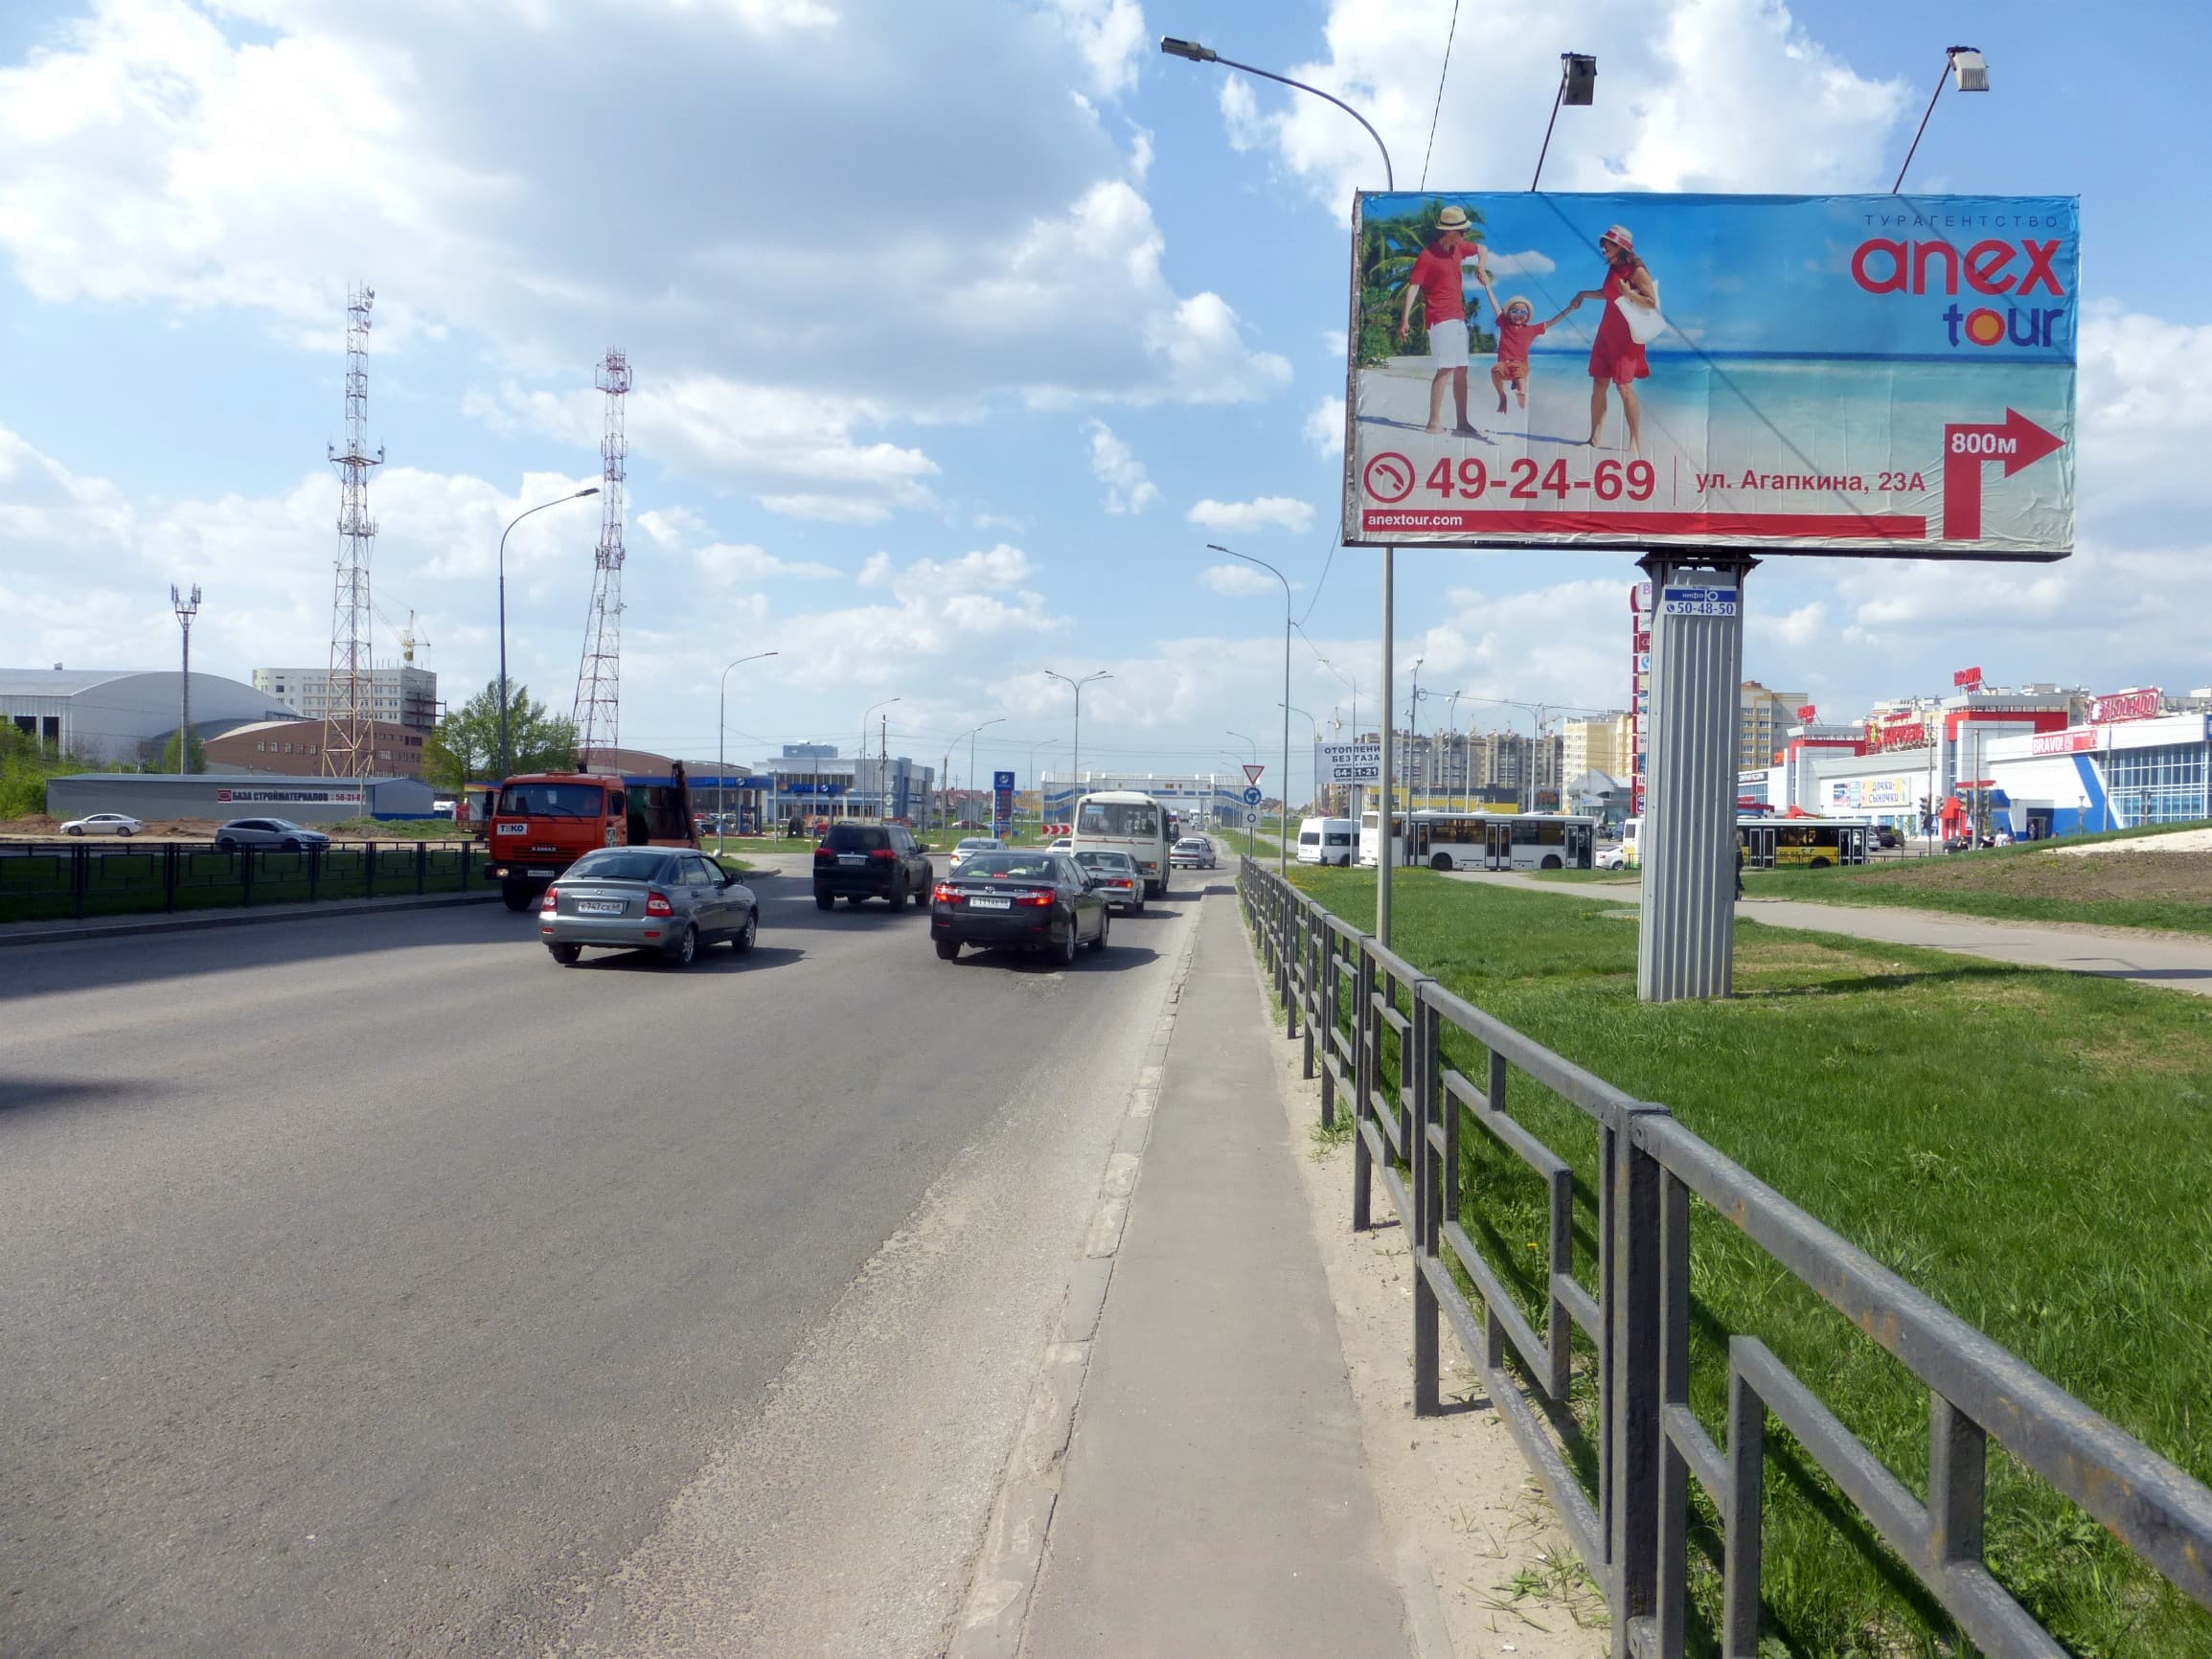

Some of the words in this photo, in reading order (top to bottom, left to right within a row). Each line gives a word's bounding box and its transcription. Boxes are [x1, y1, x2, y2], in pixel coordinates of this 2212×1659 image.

[1864, 215, 2058, 228] ТУРАГЕНТСТВО
[1851, 238, 2065, 296] anex
[1942, 303, 2065, 348] tour
[1950, 433, 2018, 455] 800м
[1425, 457, 1656, 502] 49-24-69
[1695, 472, 1732, 494] ул.
[1740, 469, 1870, 496] Агапкина,
[1367, 513, 1463, 527] anextour.com
[1676, 602, 1734, 615] 50-48-50
[1324, 745, 1380, 754] ОТОПЛЕНИ
